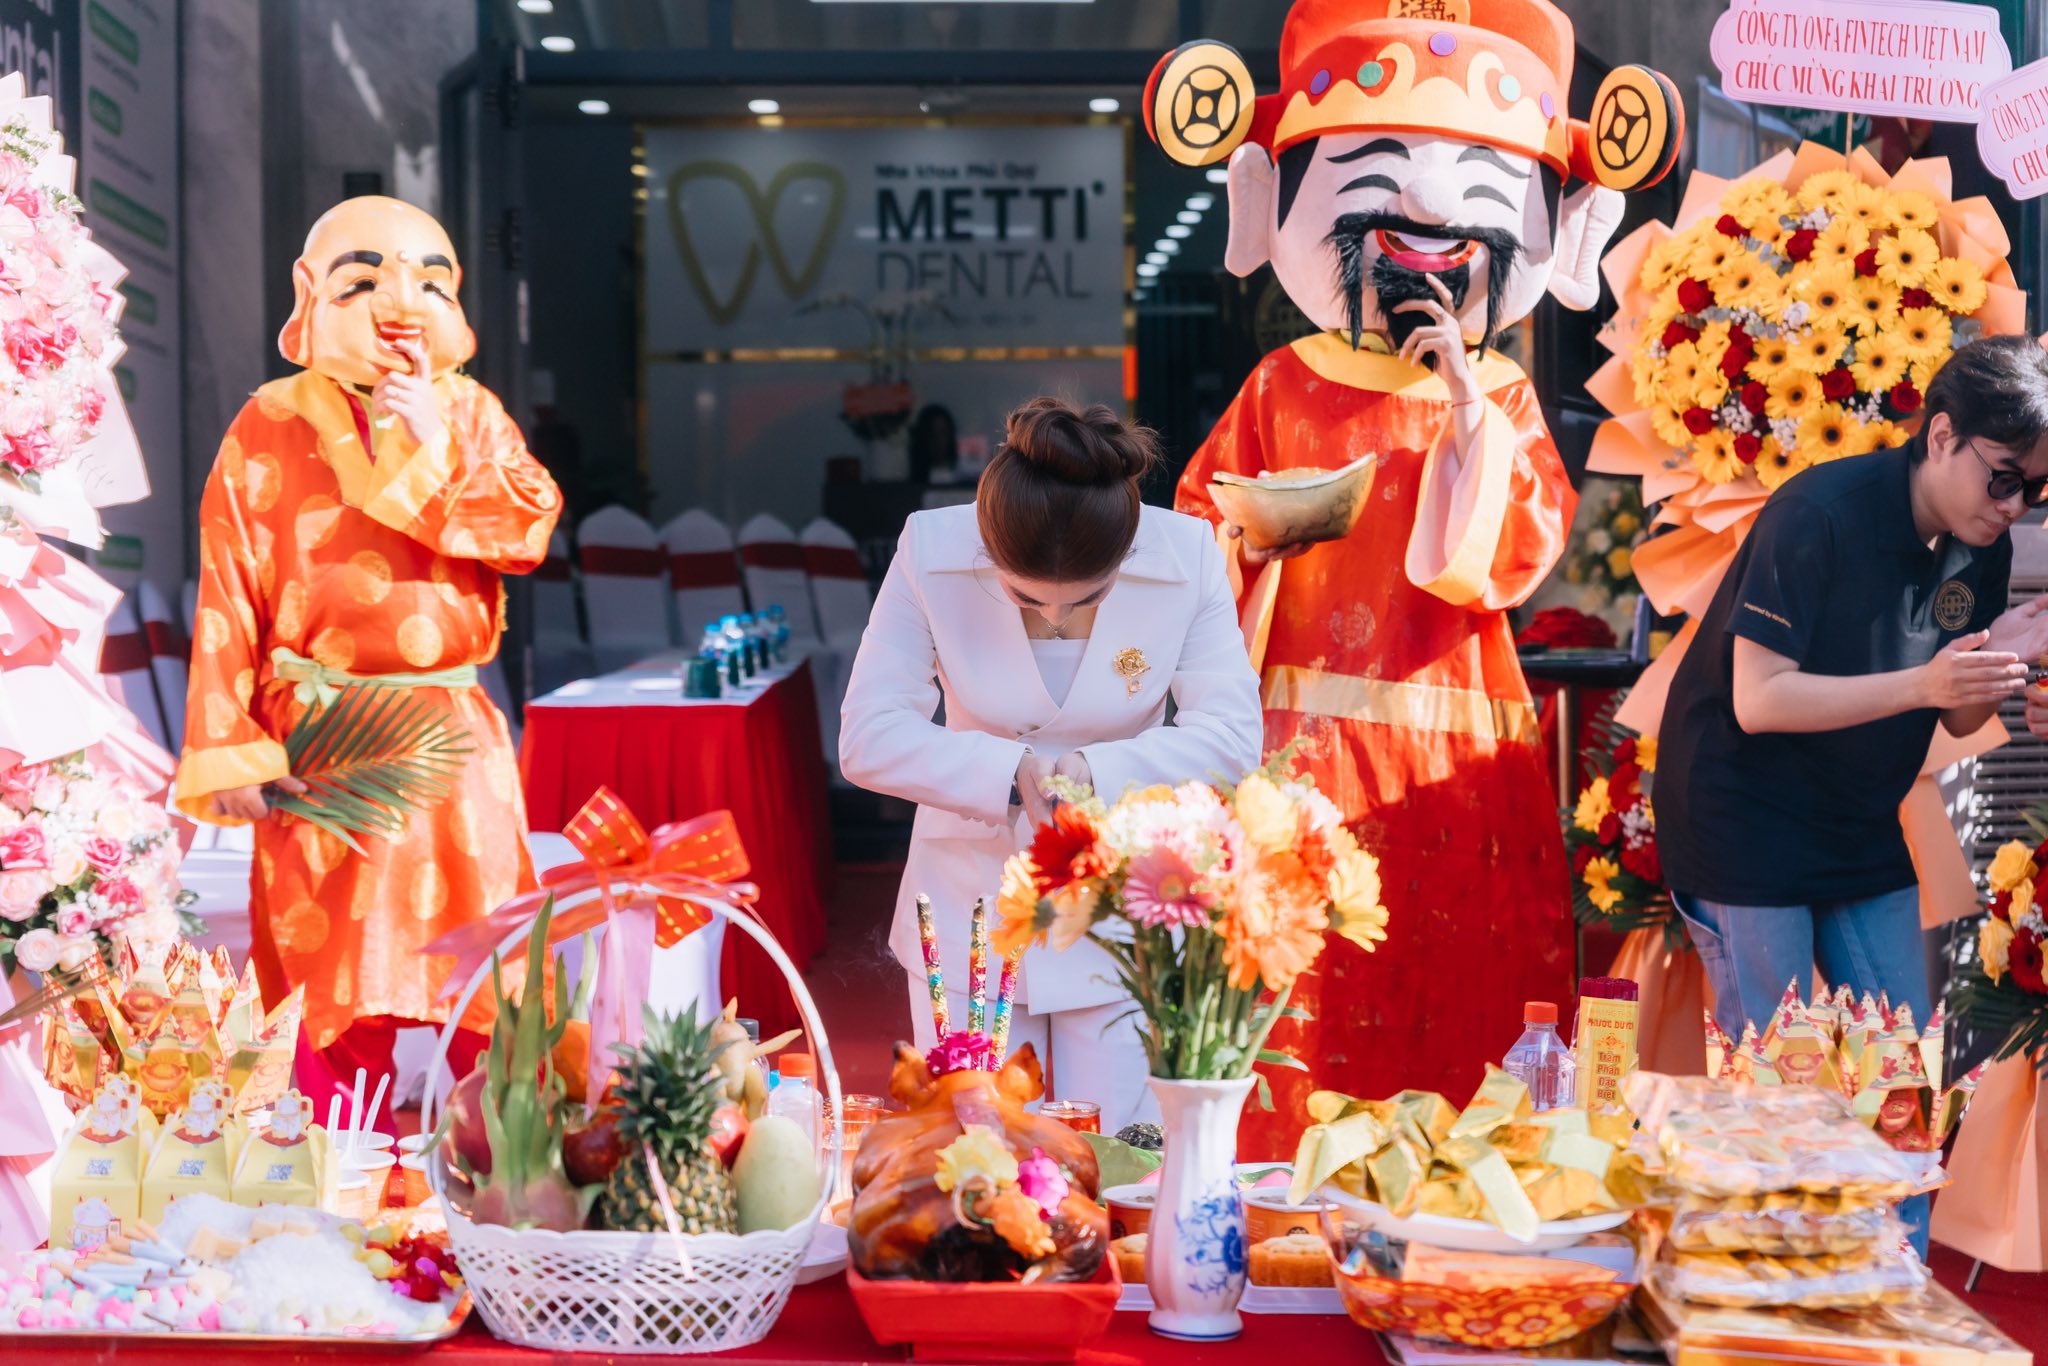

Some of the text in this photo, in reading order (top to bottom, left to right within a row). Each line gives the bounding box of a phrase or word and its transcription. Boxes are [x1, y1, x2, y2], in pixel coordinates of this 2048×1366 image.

[1737, 0, 1987, 69] CÔNG TY ONFA FINTECH VIỆT NAM
[1735, 54, 1981, 109] CHÚC MỪNG KHAI TRƯƠNG
[1992, 93, 2031, 143] CÔNG
[2022, 91, 2046, 129] TY
